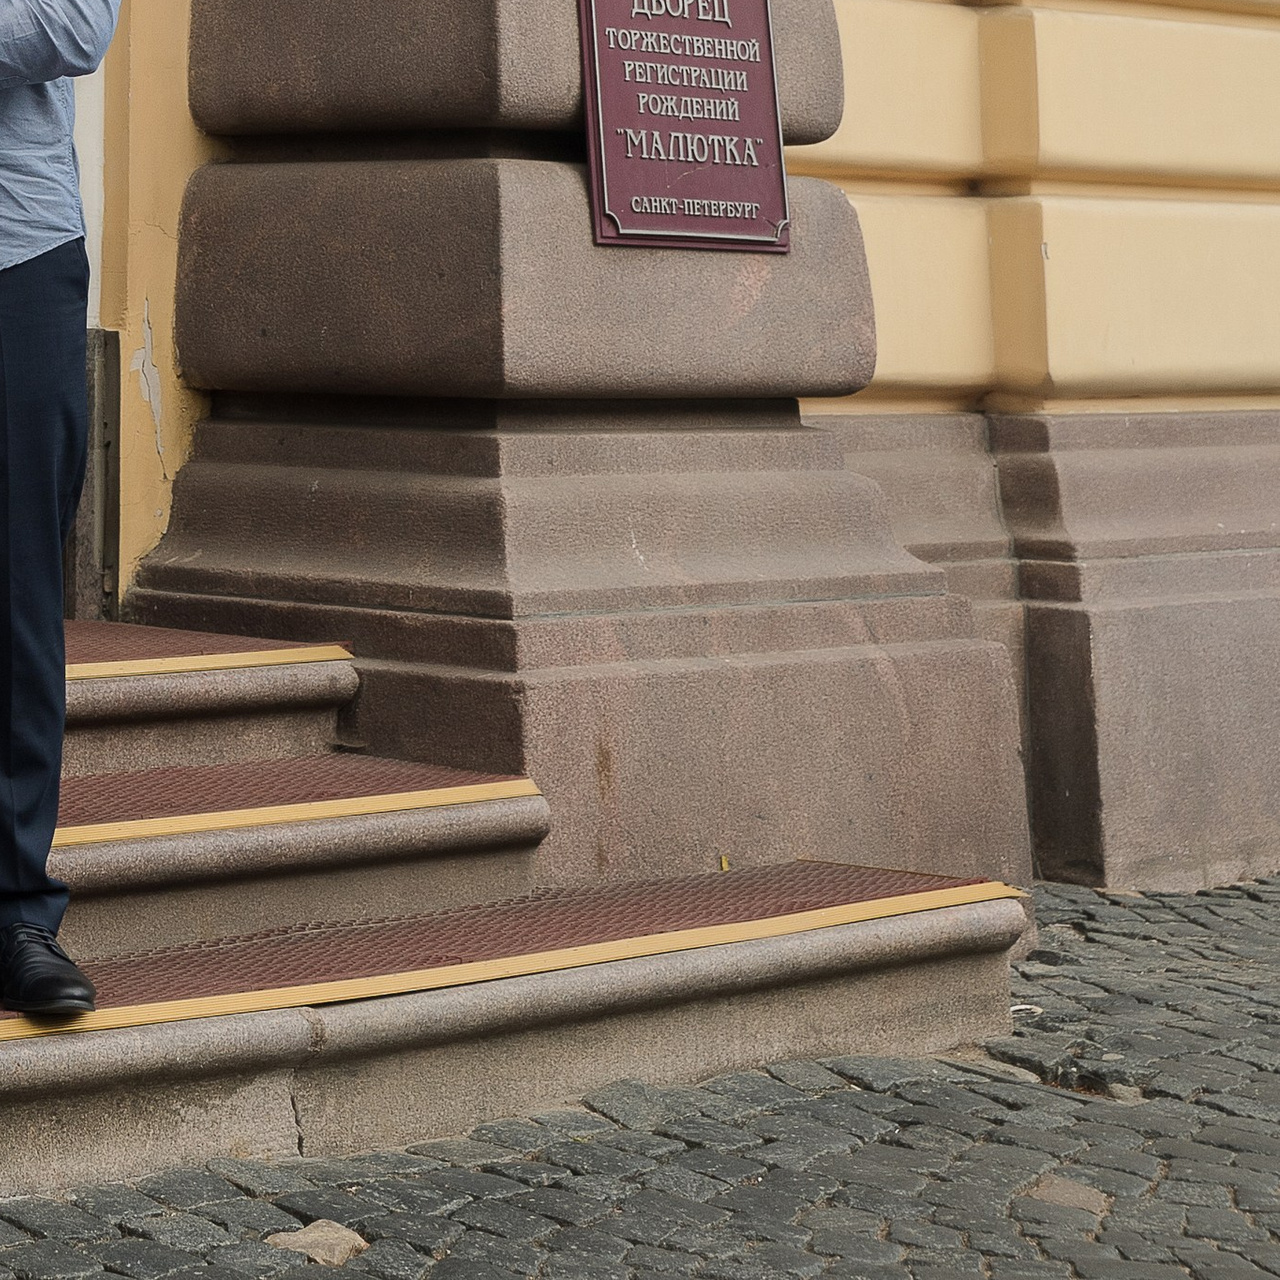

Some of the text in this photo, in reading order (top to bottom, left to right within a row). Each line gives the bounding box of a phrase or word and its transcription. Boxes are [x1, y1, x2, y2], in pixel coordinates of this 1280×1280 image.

[605, 27, 761, 62] ТОРЖЕСТВЕННОЙ
[623, 60, 748, 93] РЕГИСТРАЦИИ
[637, 93, 740, 121] РОЖДЕНИЙ
[631, 196, 760, 218] САНКТ-ПЕТЕРБУРГ
